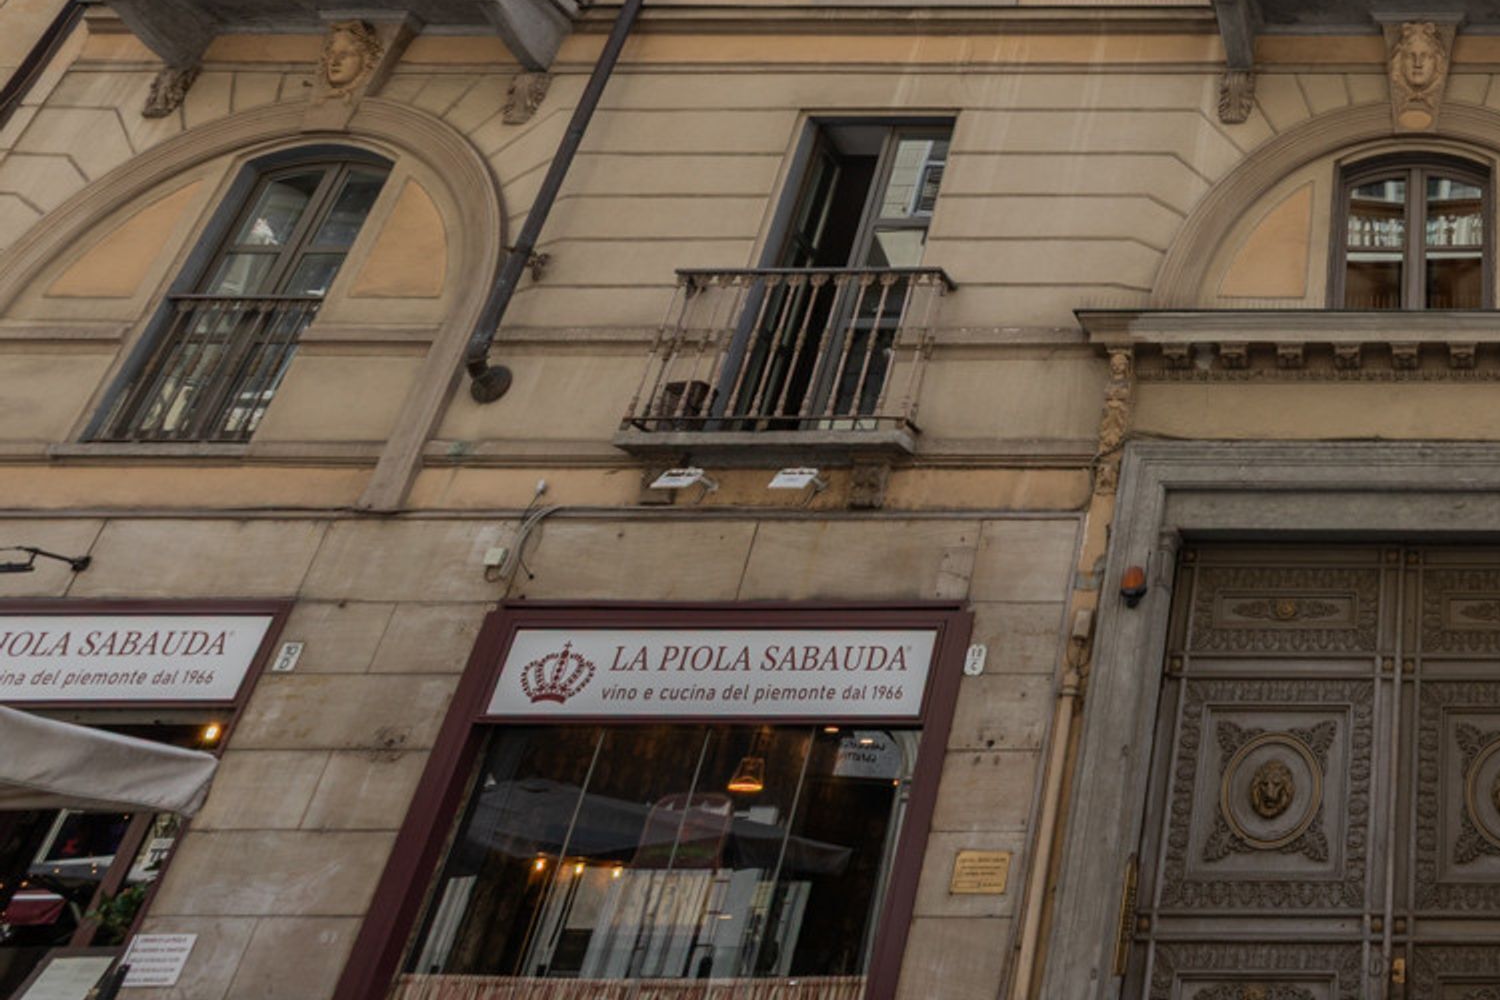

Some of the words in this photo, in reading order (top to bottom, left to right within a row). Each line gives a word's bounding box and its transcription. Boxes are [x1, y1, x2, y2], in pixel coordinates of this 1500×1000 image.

[77, 631, 227, 657] SABAUDA
[608, 645, 649, 671] LA
[657, 645, 751, 672] PIOLA
[759, 645, 908, 671] SABAUDA
[30, 668, 61, 685] del
[61, 669, 147, 688] piemonte
[151, 670, 178, 685] dal
[182, 670, 215, 685] 1966
[601, 685, 637, 700] vino
[643, 687, 654, 700] e
[660, 684, 717, 700] cucina
[722, 684, 750, 700] del
[754, 684, 836, 704] piemonte
[842, 685, 867, 700] dal
[872, 685, 903, 700] 1966
